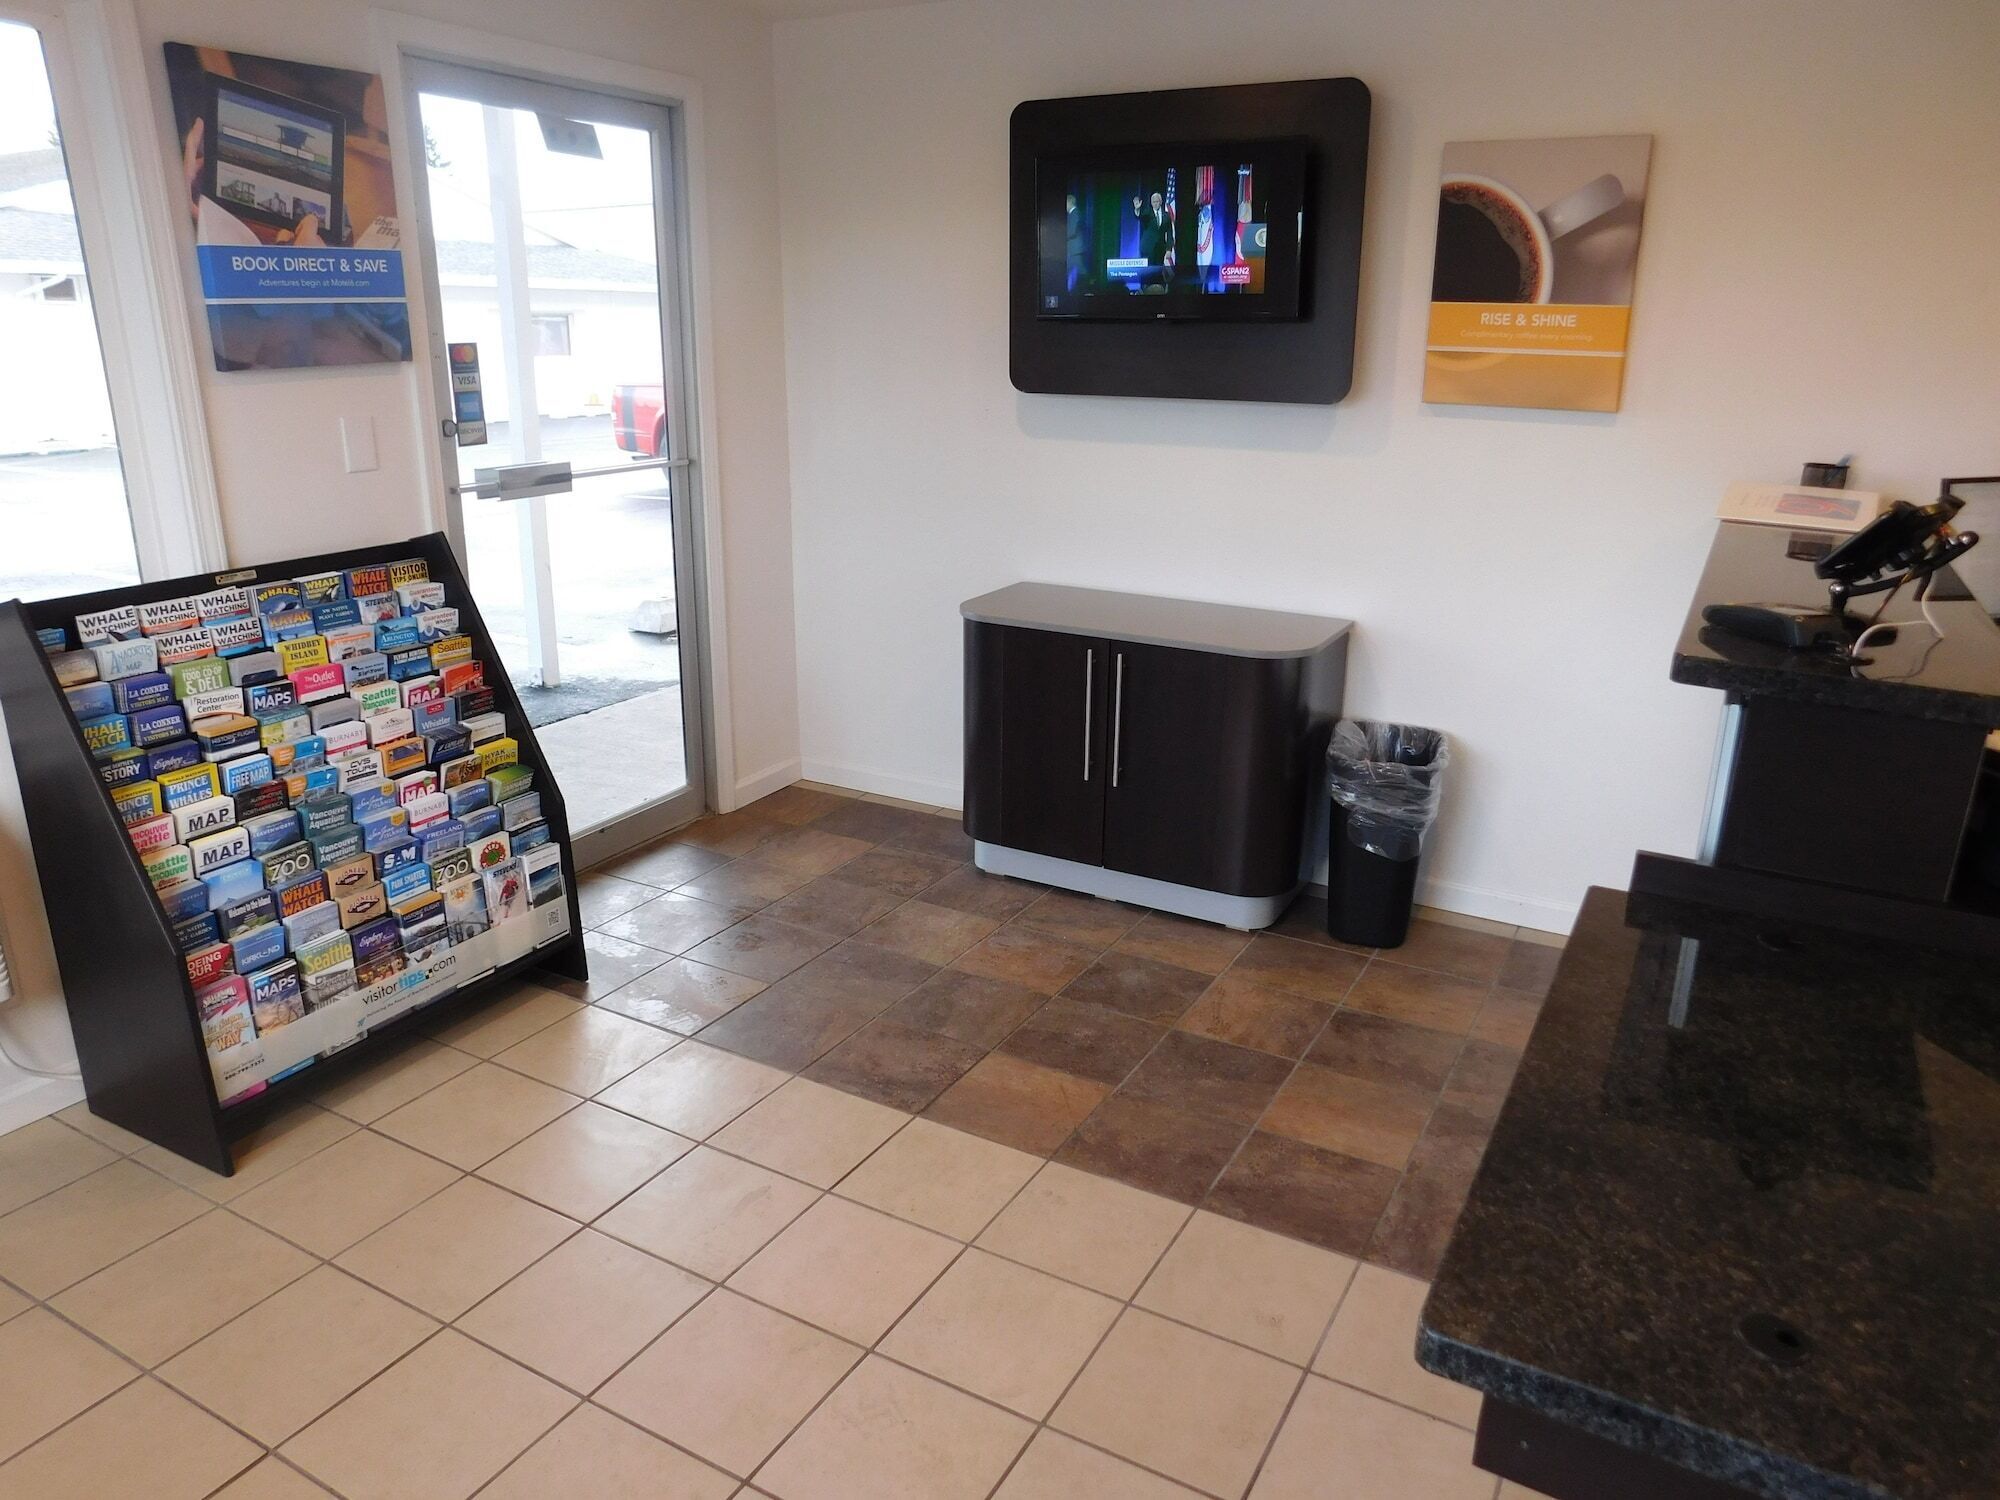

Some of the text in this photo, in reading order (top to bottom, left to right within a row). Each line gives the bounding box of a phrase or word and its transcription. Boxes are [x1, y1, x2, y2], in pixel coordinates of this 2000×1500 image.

[232, 256, 388, 273] BOOK DIRECT & SAVE
[1221, 266, 1250, 276] C-SPAN2
[258, 278, 370, 288] Adventures begin at Motel6.com
[1480, 312, 1577, 327] RISE & SHINE
[1460, 330, 1513, 340] Complimentary
[1514, 331, 1538, 339] coffee
[458, 375, 478, 385] VISA
[352, 568, 386, 585] WHALE
[392, 562, 426, 577] VISITOR
[304, 576, 340, 588] WHALE
[352, 582, 388, 596] WATCH
[409, 584, 442, 596] Guaranteed
[200, 592, 246, 608] WHALE
[258, 587, 300, 601] WHALES
[145, 600, 194, 618] WHALE
[202, 602, 248, 616] WATCHING
[422, 610, 456, 621] Guaranteed
[81, 608, 134, 628] WHALE
[147, 612, 197, 626] WATCHING
[83, 620, 138, 638] WATCHING
[215, 620, 259, 636] WHALE
[158, 630, 209, 648] WHALE
[217, 630, 261, 646] WATCHING
[284, 638, 321, 652] WHIDBEY
[162, 641, 212, 656] WATCHING
[290, 648, 320, 660] ISLAND
[437, 640, 468, 654] Seattle
[182, 669, 200, 682] FOOD
[202, 666, 222, 678] CO-OP
[312, 670, 336, 684] Outlet
[128, 684, 169, 698] LA CONNER
[186, 674, 224, 695] & DELI
[196, 692, 240, 706] Restoration
[254, 692, 292, 710] MAPS
[362, 687, 397, 700] Seattle
[410, 688, 440, 706] MAP
[197, 703, 222, 714] Center
[362, 696, 397, 711] Vancouver
[140, 716, 181, 732] LA CONNER
[422, 716, 450, 730] Whistler
[88, 730, 126, 750] ATCH
[328, 730, 364, 744] BURNABY
[484, 748, 506, 760] HYAK
[345, 763, 378, 776] TOURS
[350, 757, 372, 768] CVS
[170, 775, 208, 795] PRINCE
[232, 766, 270, 789] FREE MAP
[170, 788, 213, 810] WHALES
[404, 784, 436, 804] MAP
[116, 795, 150, 813] RINCE
[414, 800, 446, 816] BURNABY
[123, 808, 154, 824] ALES
[188, 808, 230, 833] MAP
[309, 805, 348, 820] Vancouver
[308, 814, 346, 830] Aquarium
[133, 822, 169, 840] ncouver
[426, 824, 462, 840] FREELAND
[136, 832, 170, 850] eattle
[318, 836, 358, 854] Vancouver
[202, 840, 244, 866] MAP
[320, 846, 356, 864] Aquarium
[152, 864, 188, 882] ncouver
[268, 854, 310, 882] ZOO
[434, 860, 468, 885] ZOO
[282, 880, 322, 905] WHALE
[282, 892, 325, 916] WATCH
[188, 952, 222, 971] OEING
[304, 943, 352, 976] Seattle
[189, 964, 212, 980] OUR
[256, 974, 296, 1000] MAPS
[216, 1031, 241, 1052] WAY
